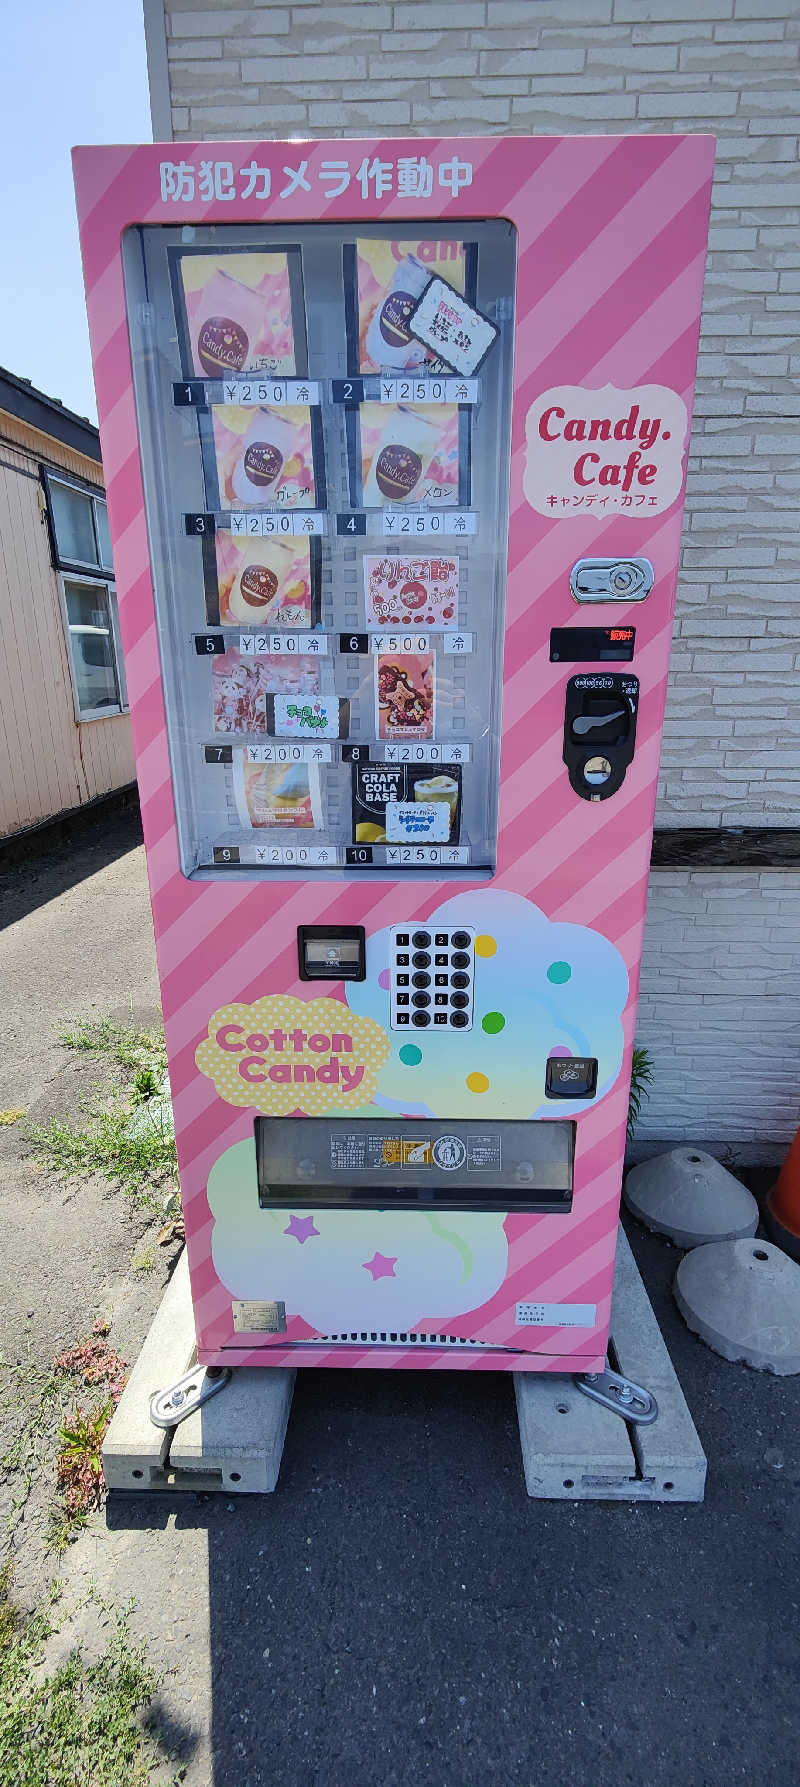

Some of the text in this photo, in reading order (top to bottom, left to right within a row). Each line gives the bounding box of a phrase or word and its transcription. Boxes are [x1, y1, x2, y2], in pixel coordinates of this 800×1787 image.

[159, 156, 474, 202] 防犯カメラ作動中
[249, 358, 282, 371] いちご
[184, 384, 310, 402] 1 ¥250 冷
[343, 383, 468, 399] 2 ¥250 冷
[538, 404, 671, 450] Candy.
[573, 450, 658, 492] Cafe
[423, 486, 453, 499] メロン
[545, 495, 658, 507] キャンディ・カフェ
[195, 516, 315, 533] 3 ¥250 冷
[346, 516, 466, 532] 4 ¥250 冷
[379, 559, 449, 582] りんご飴
[609, 629, 633, 641] 販売中
[206, 638, 319, 652] 5 ¥250 冷
[349, 636, 464, 650] 6 ¥500 冷
[215, 747, 324, 761] 7 ¥200 冷
[351, 747, 462, 760] 8 ¥200 冷
[361, 773, 401, 783] CRAFT
[365, 783, 397, 793] COLA
[365, 793, 398, 802] BASE
[222, 848, 329, 861] 9 ¥200 冷
[351, 849, 460, 861] 10 ¥250 冷
[216, 1024, 353, 1054] Cotton
[238, 1056, 365, 1092] Candy
